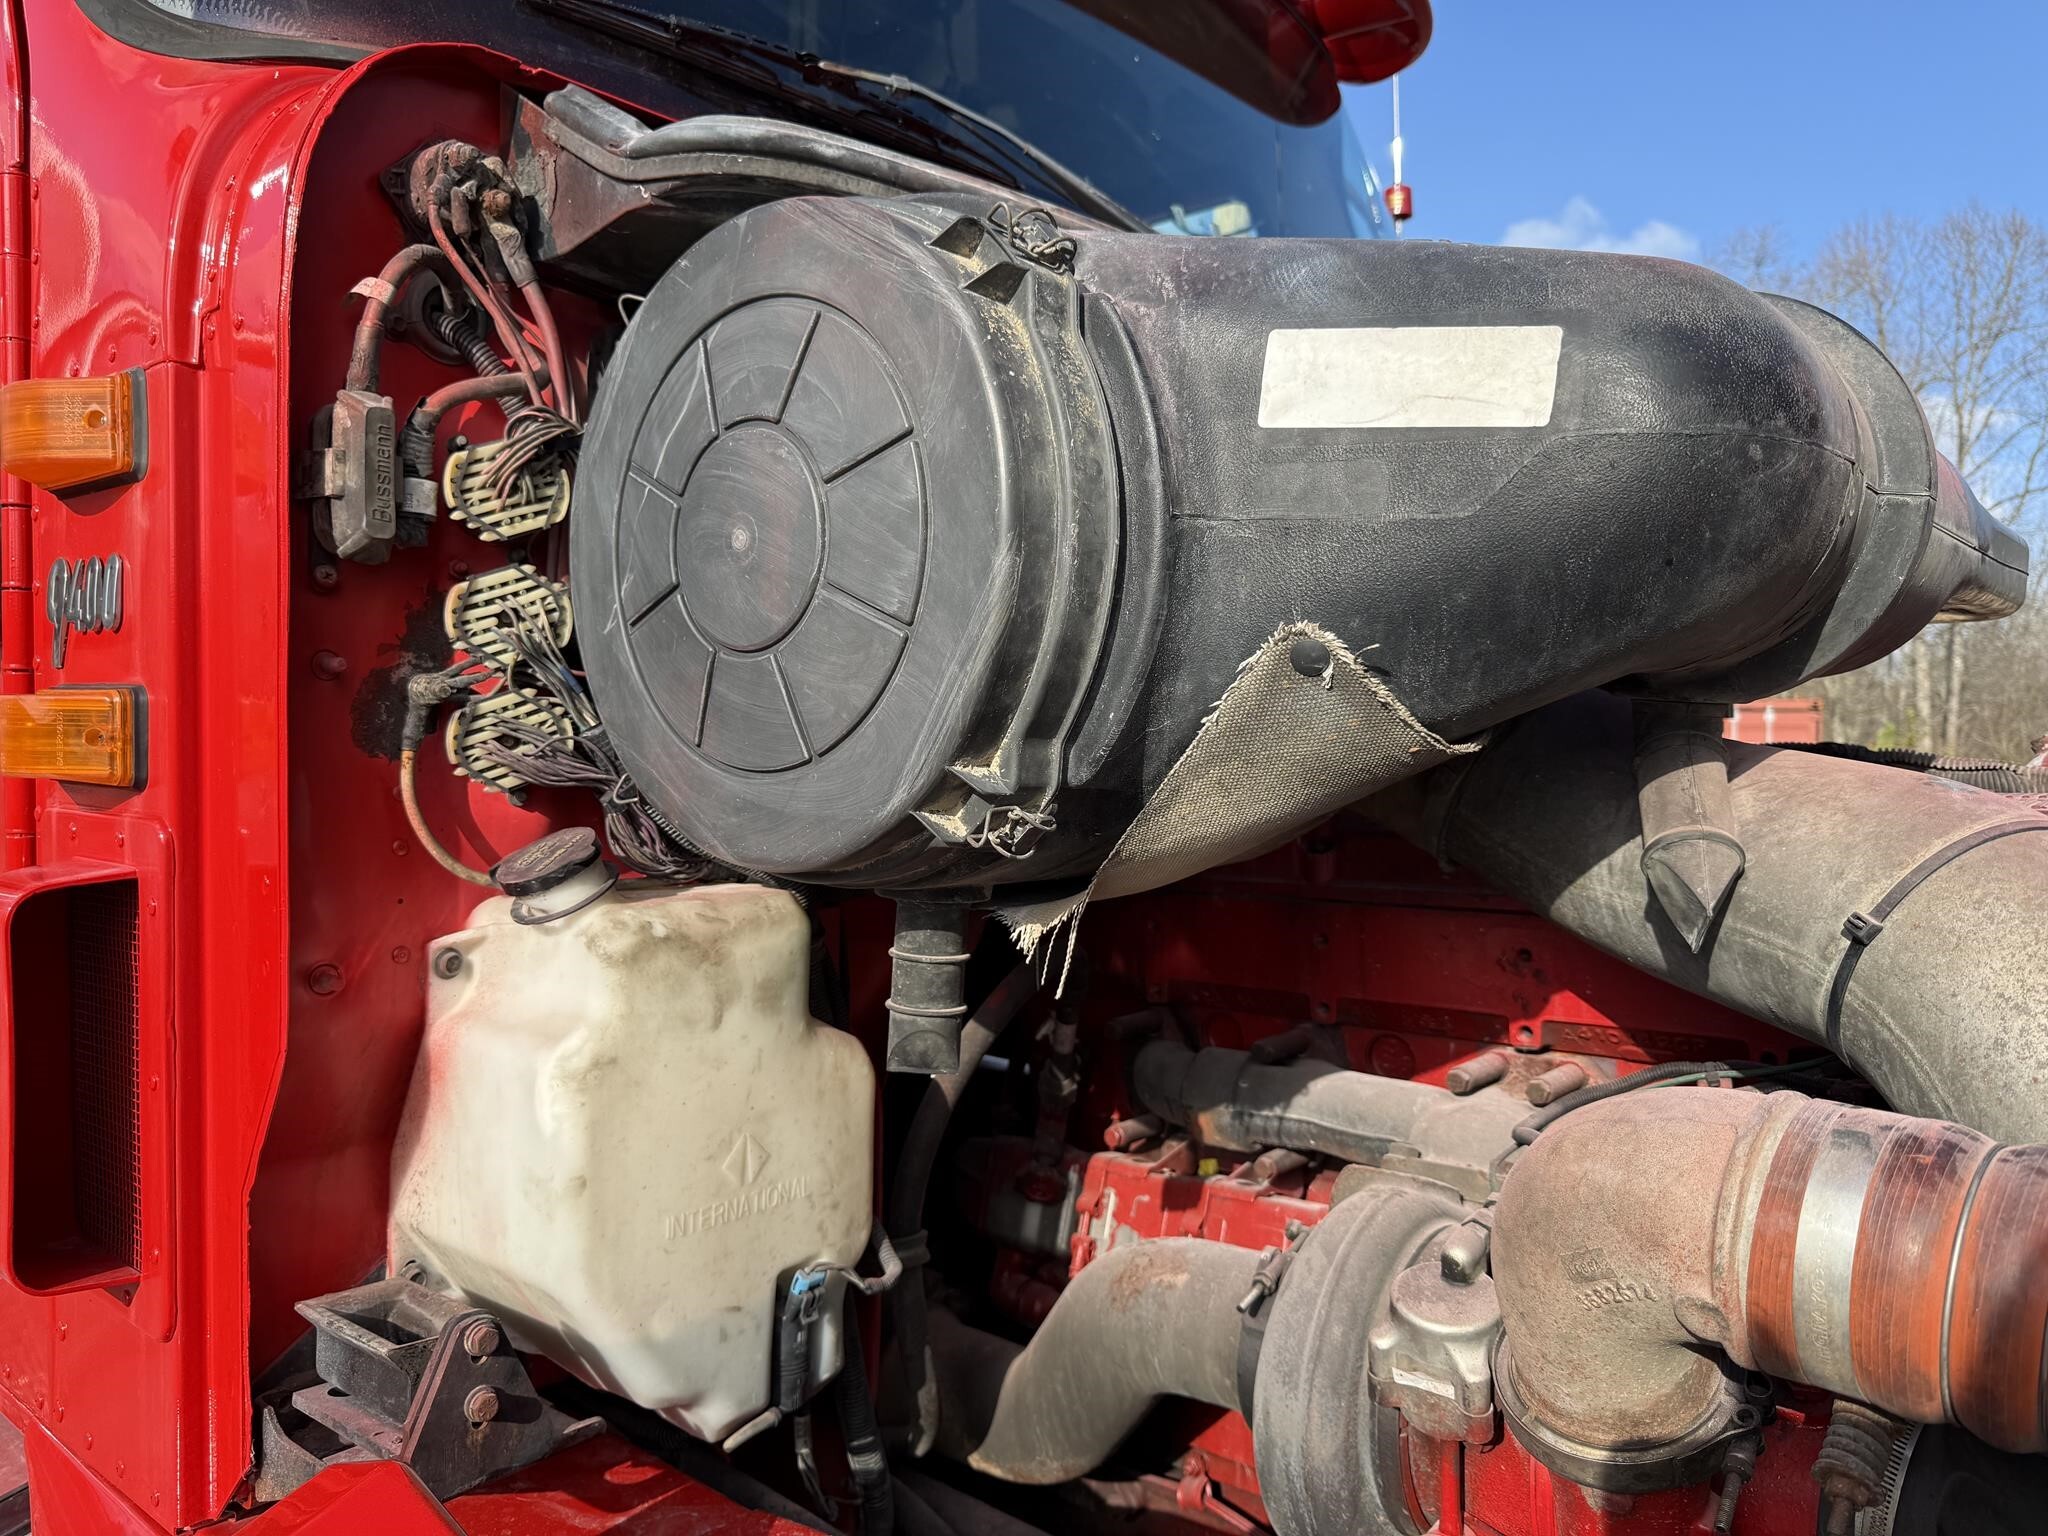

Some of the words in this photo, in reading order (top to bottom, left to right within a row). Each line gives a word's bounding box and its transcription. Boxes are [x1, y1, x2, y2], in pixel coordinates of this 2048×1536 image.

[372, 423, 393, 524] Bussmann
[47, 552, 123, 670] 9400
[665, 1175, 809, 1241] INTERNATIONAL
